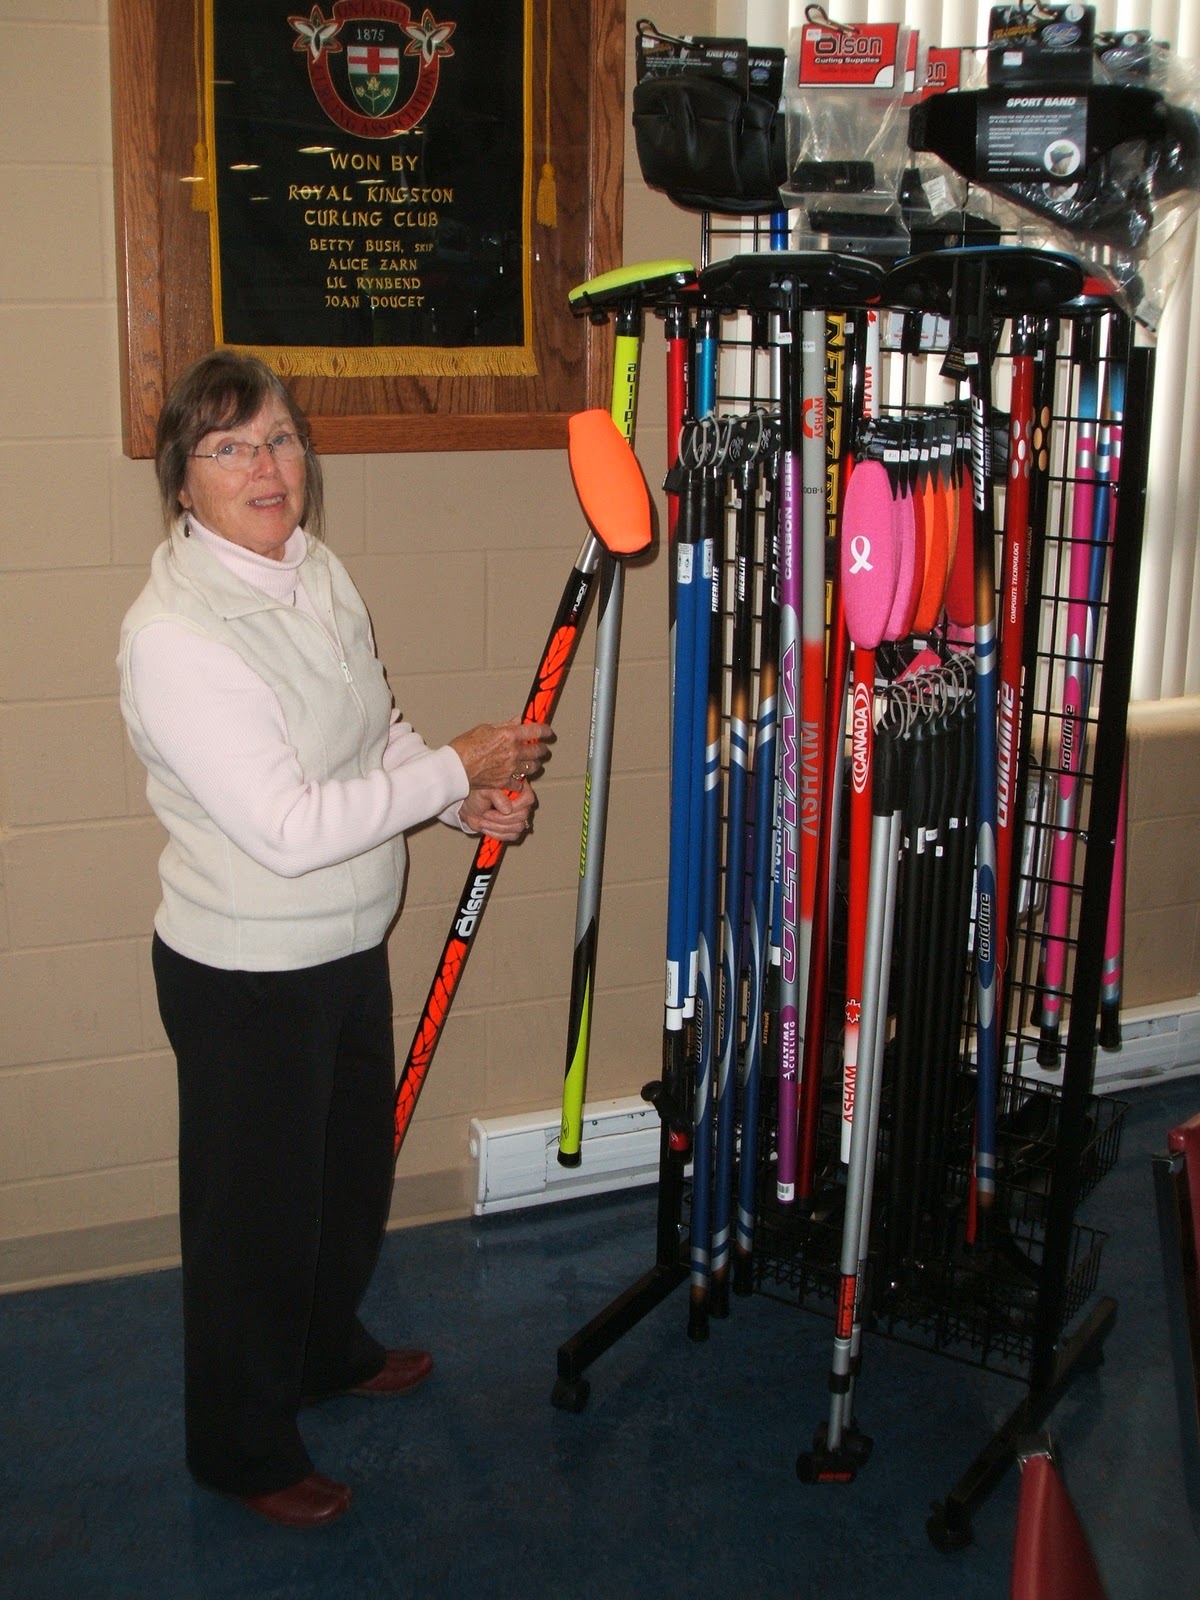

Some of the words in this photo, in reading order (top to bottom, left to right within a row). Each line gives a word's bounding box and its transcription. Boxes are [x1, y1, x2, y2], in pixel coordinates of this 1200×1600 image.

[356, 29, 385, 41] 1875
[706, 50, 723, 58] KNEE
[724, 51, 739, 59] PAD
[814, 56, 844, 65] Curling
[845, 57, 880, 65] Supplies
[1006, 97, 1043, 108] SPORT
[1044, 97, 1077, 107] BAND
[329, 153, 381, 171] WON
[391, 155, 419, 171] BY
[288, 184, 353, 201] ROYAL
[367, 186, 454, 204] KINGSTON
[304, 210, 383, 227] CURLING
[393, 211, 439, 228] CLUB
[309, 239, 354, 251] BETTY
[328, 258, 368, 271] ALICE
[380, 259, 417, 271] ZARN
[326, 277, 347, 289] LIL
[325, 295, 360, 308] JOAN
[370, 295, 425, 308] DOUCET
[814, 397, 824, 439] ASHAM
[784, 450, 792, 502] FIBER
[784, 506, 792, 580] CARBON
[1011, 541, 1020, 585] TECHNOLOGY
[711, 565, 720, 613] FIBERLITE
[738, 556, 746, 602] FIBERLITE
[1010, 586, 1018, 623] COMPOSITE
[853, 706, 869, 773] CANADA
[801, 721, 818, 836] ASHAM
[782, 640, 798, 984] ULTIMA
[979, 893, 991, 962] Goldline
